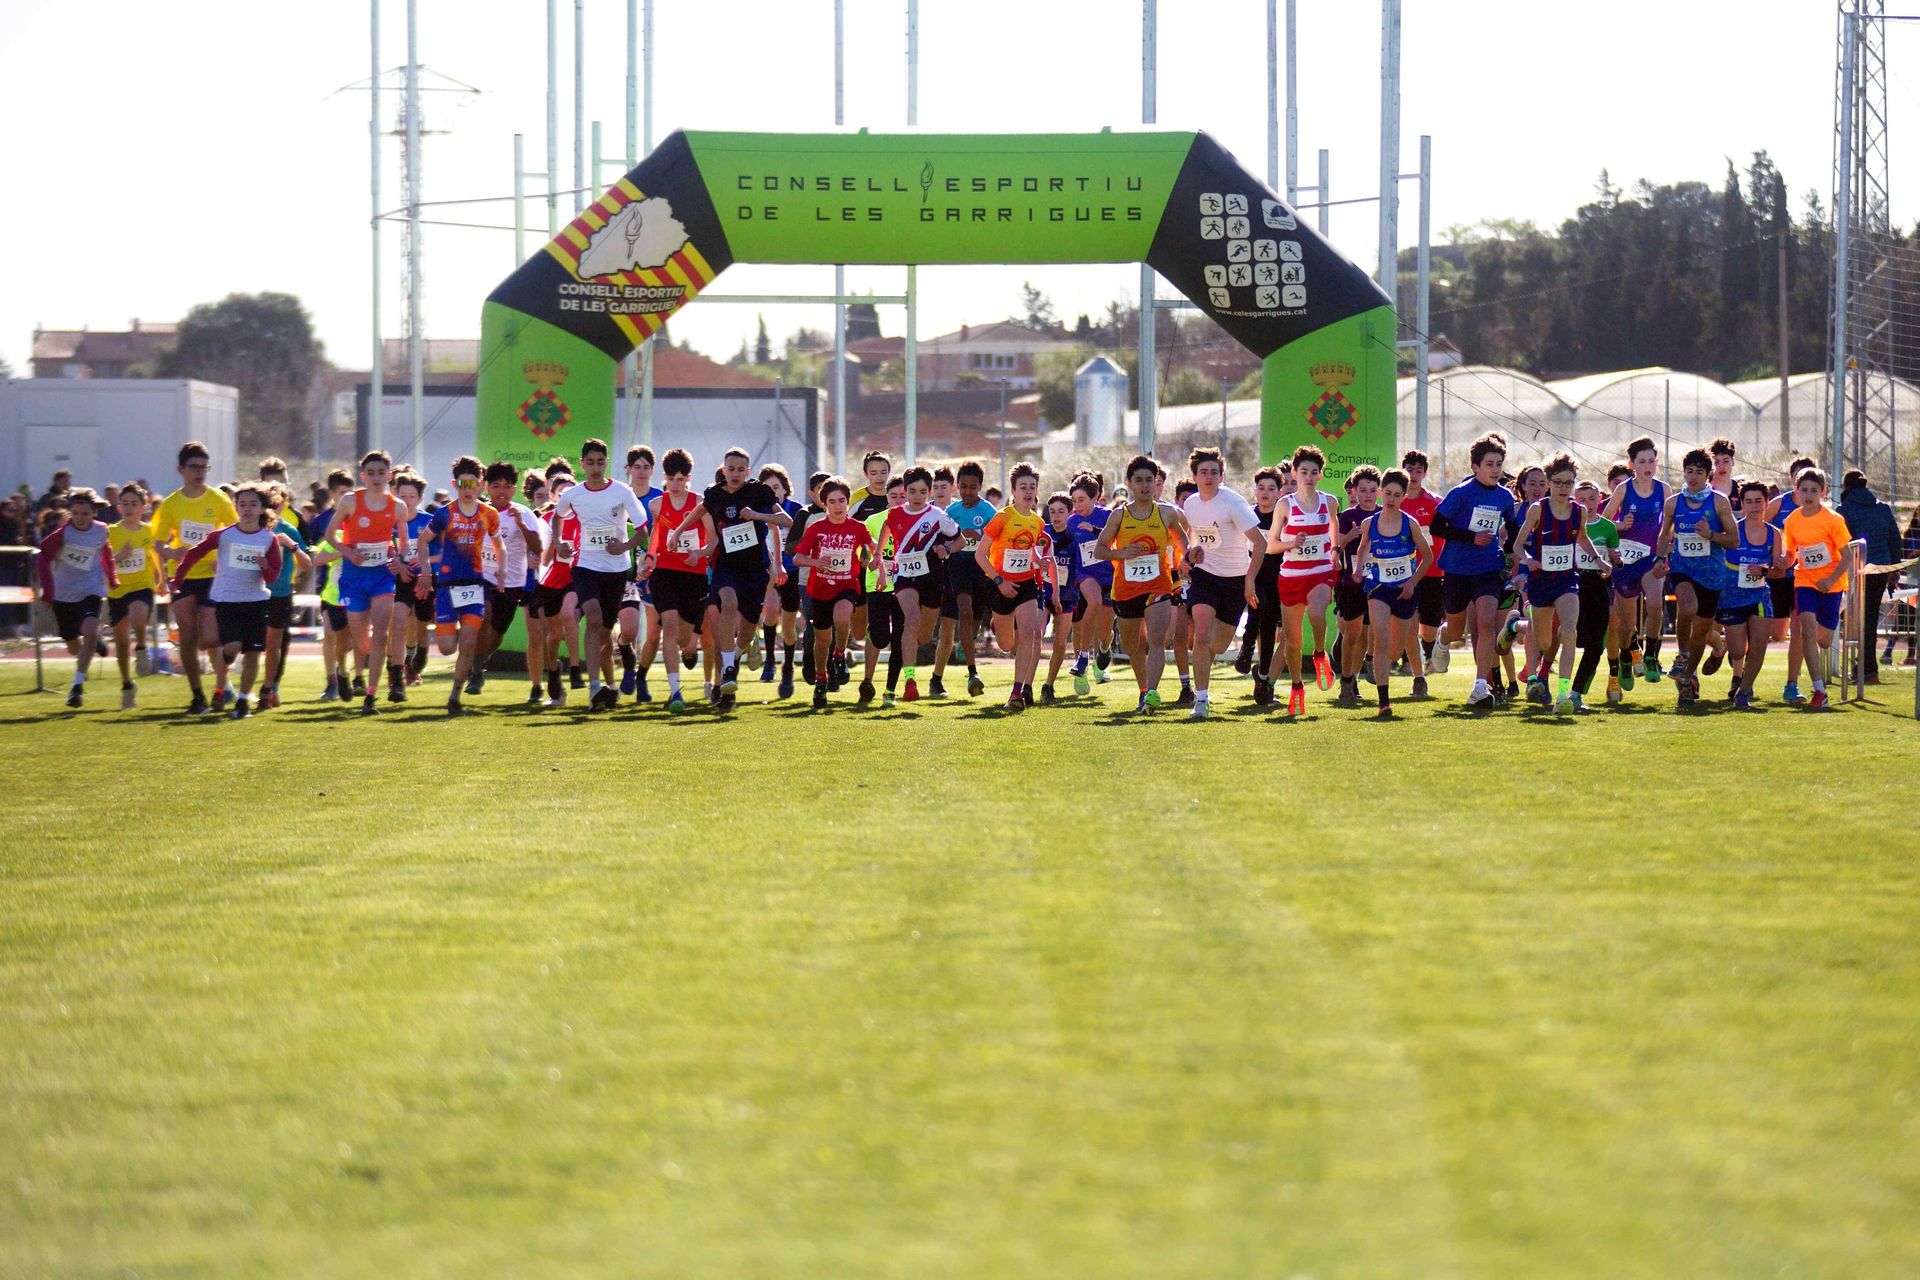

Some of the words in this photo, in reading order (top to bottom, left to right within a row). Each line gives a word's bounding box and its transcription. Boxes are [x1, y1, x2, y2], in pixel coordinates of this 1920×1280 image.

[738, 175, 908, 192] CONSELL
[946, 176, 1141, 192] ESPORTIU
[738, 206, 779, 221] DE
[816, 207, 882, 221] LES
[920, 207, 1141, 222] GARRIGUES
[559, 283, 620, 297] CONSELL
[624, 286, 684, 298] ESPORTIU
[560, 299, 580, 310] DE
[583, 301, 606, 312] LES
[609, 300, 677, 313] GARRIGUES
[494, 450, 535, 462] Consell
[1328, 453, 1380, 466] Comarcal
[1477, 519, 1495, 529] 421
[730, 533, 751, 545] 431
[1297, 545, 1318, 555] 365
[1683, 542, 1704, 551] 503
[66, 552, 89, 564] 447
[236, 554, 258, 564] 448
[1624, 549, 1644, 559] 728
[1804, 553, 1824, 563] 429
[1010, 559, 1028, 567] 722
[1548, 555, 1569, 565] 303
[903, 561, 921, 571] 740
[1132, 566, 1153, 576] 721
[1385, 566, 1406, 576] 505
[462, 590, 475, 600] 97
